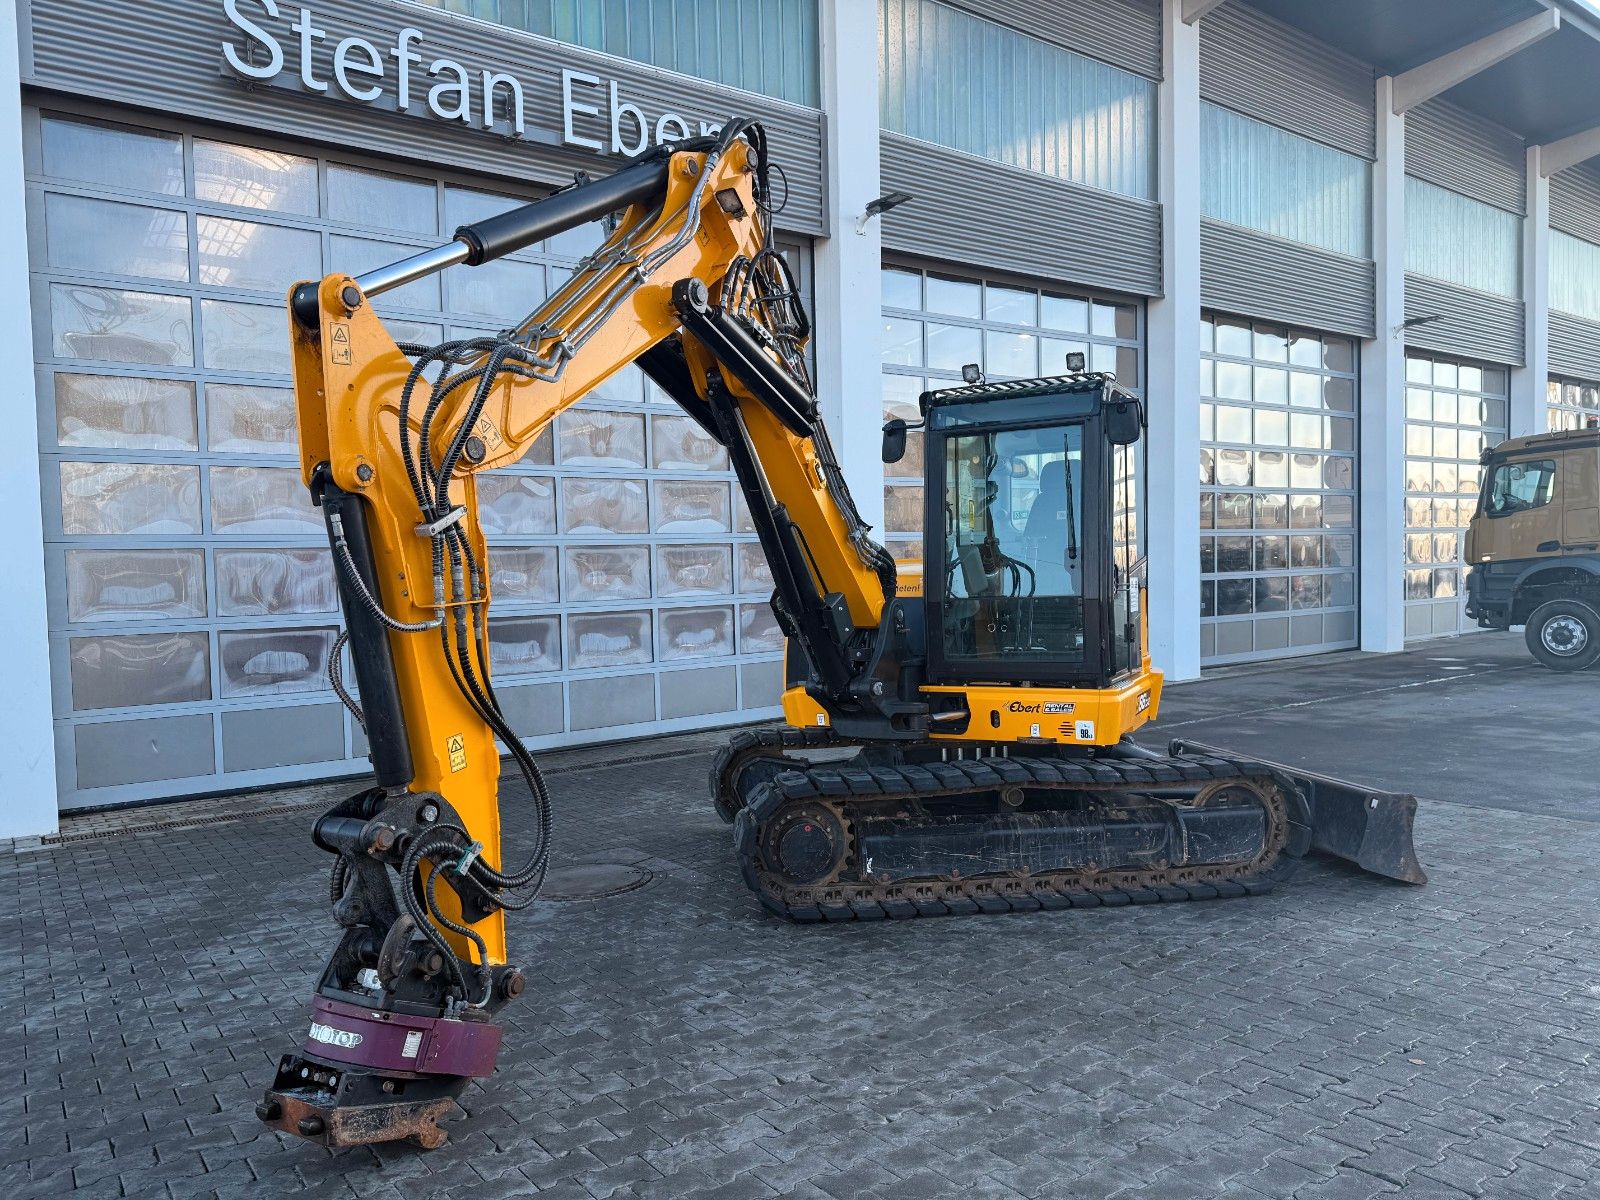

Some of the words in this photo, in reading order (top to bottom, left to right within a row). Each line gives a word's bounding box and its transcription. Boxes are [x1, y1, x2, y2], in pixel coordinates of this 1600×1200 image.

[222, 0, 524, 134] Stefan
[562, 68, 747, 157] Eber
[1009, 701, 1041, 713] Ebert
[1080, 729, 1089, 739] 98
